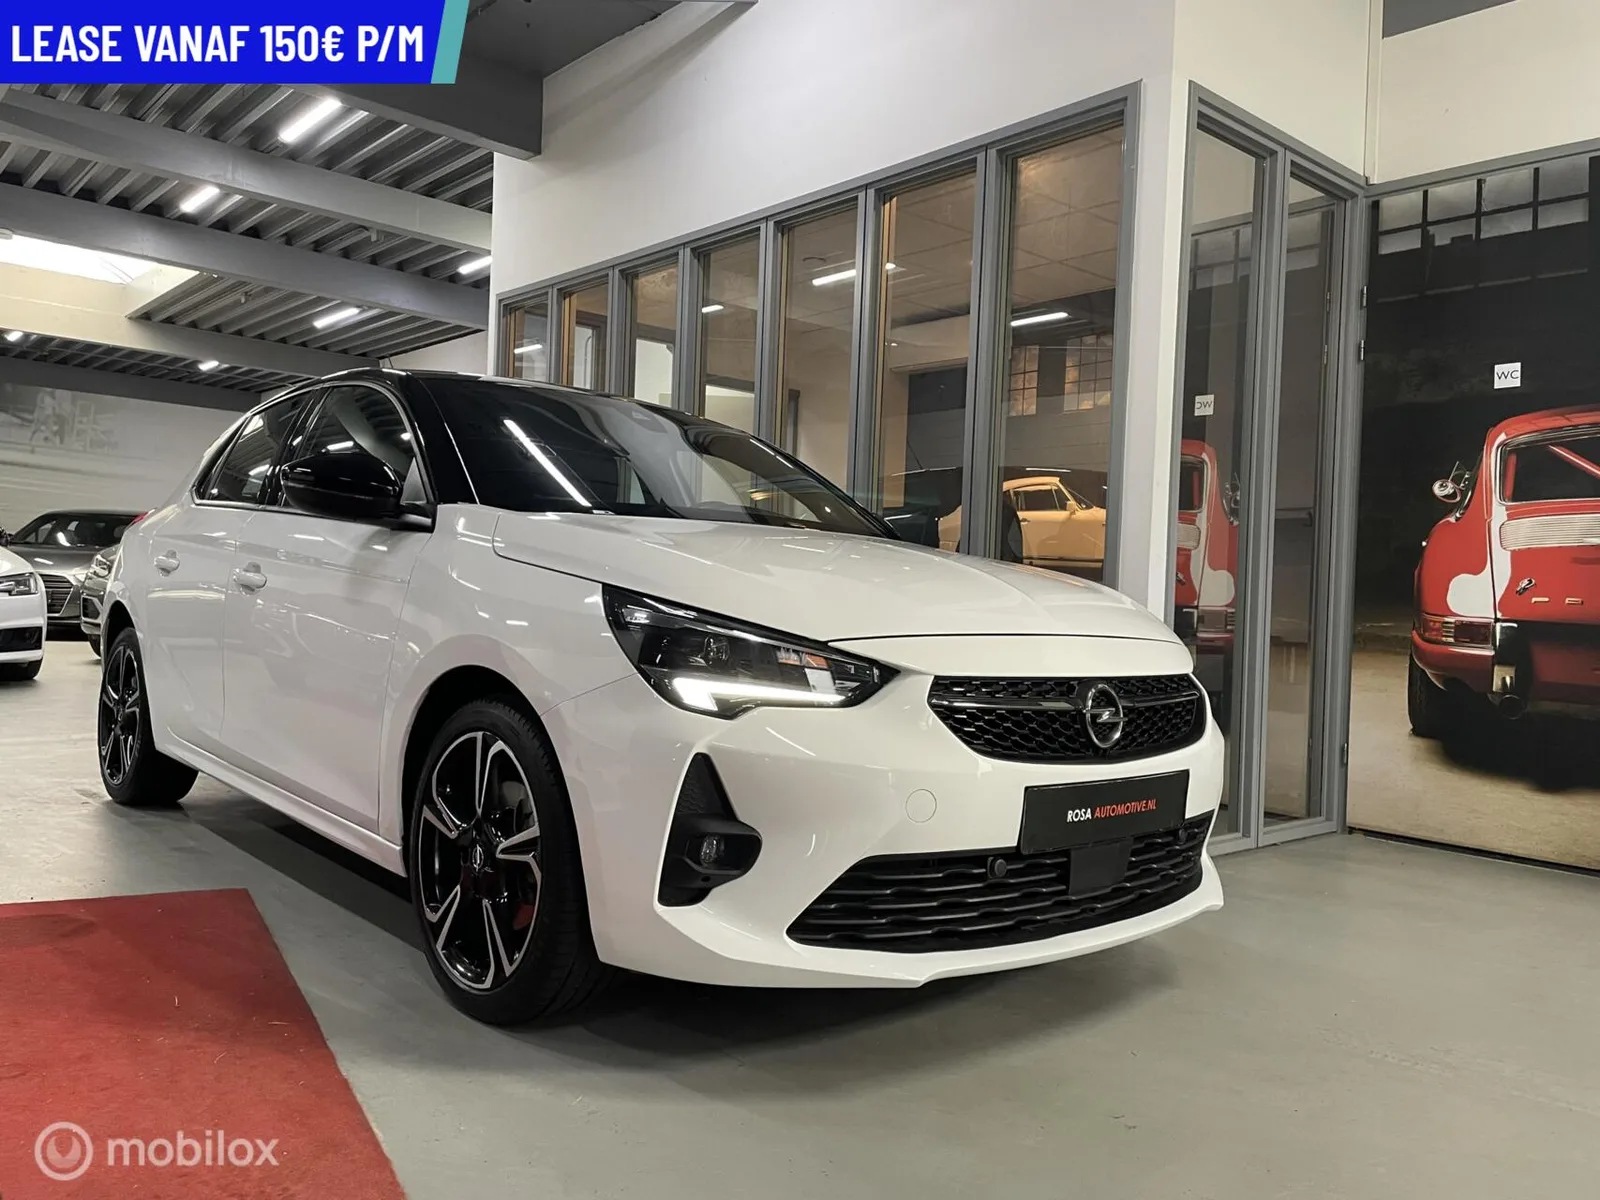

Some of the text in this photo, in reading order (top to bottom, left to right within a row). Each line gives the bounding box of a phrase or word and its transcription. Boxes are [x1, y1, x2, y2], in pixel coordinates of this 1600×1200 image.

[1496, 369, 1519, 380] WC
[1066, 798, 1157, 823] ROSA AUTOMOTIVE.NL
